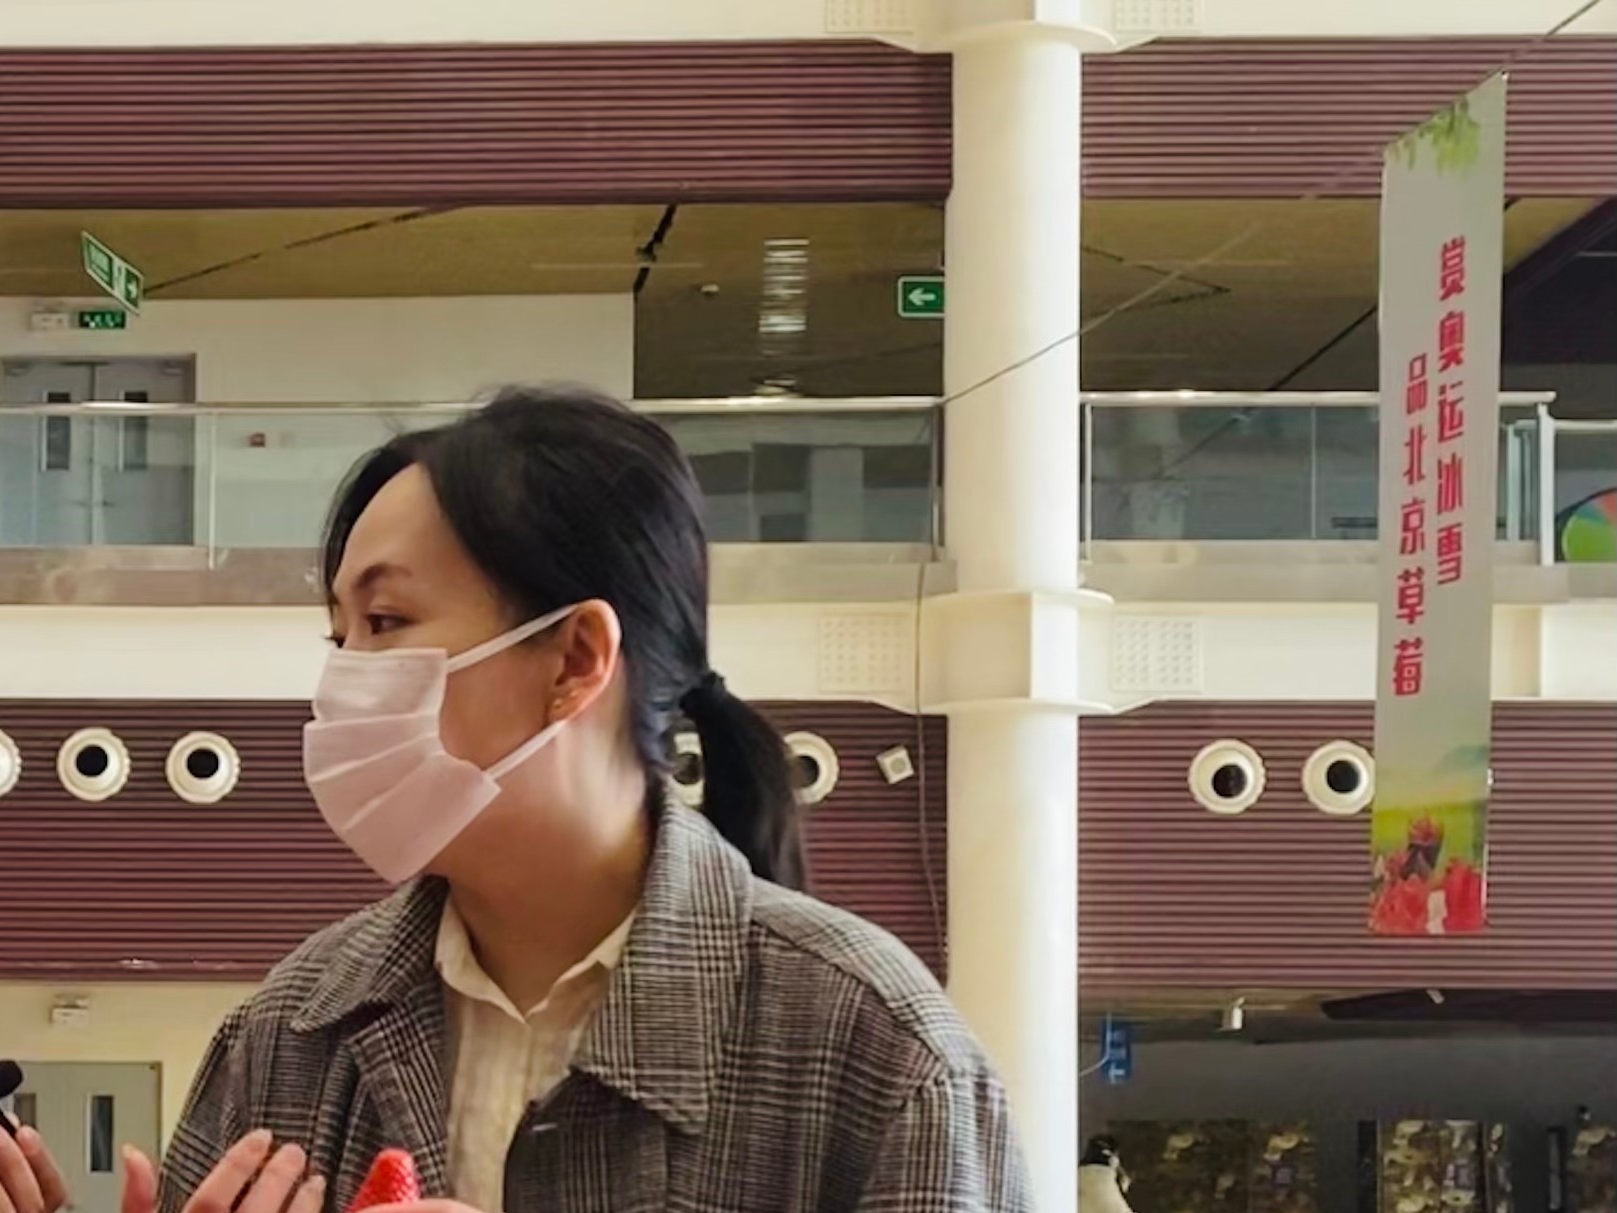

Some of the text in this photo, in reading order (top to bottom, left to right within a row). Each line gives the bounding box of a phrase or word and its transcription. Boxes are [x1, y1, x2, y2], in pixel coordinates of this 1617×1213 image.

[1392, 353, 1428, 698] 品北京草莓
[1437, 234, 1466, 586] 赏奥运冰雪
